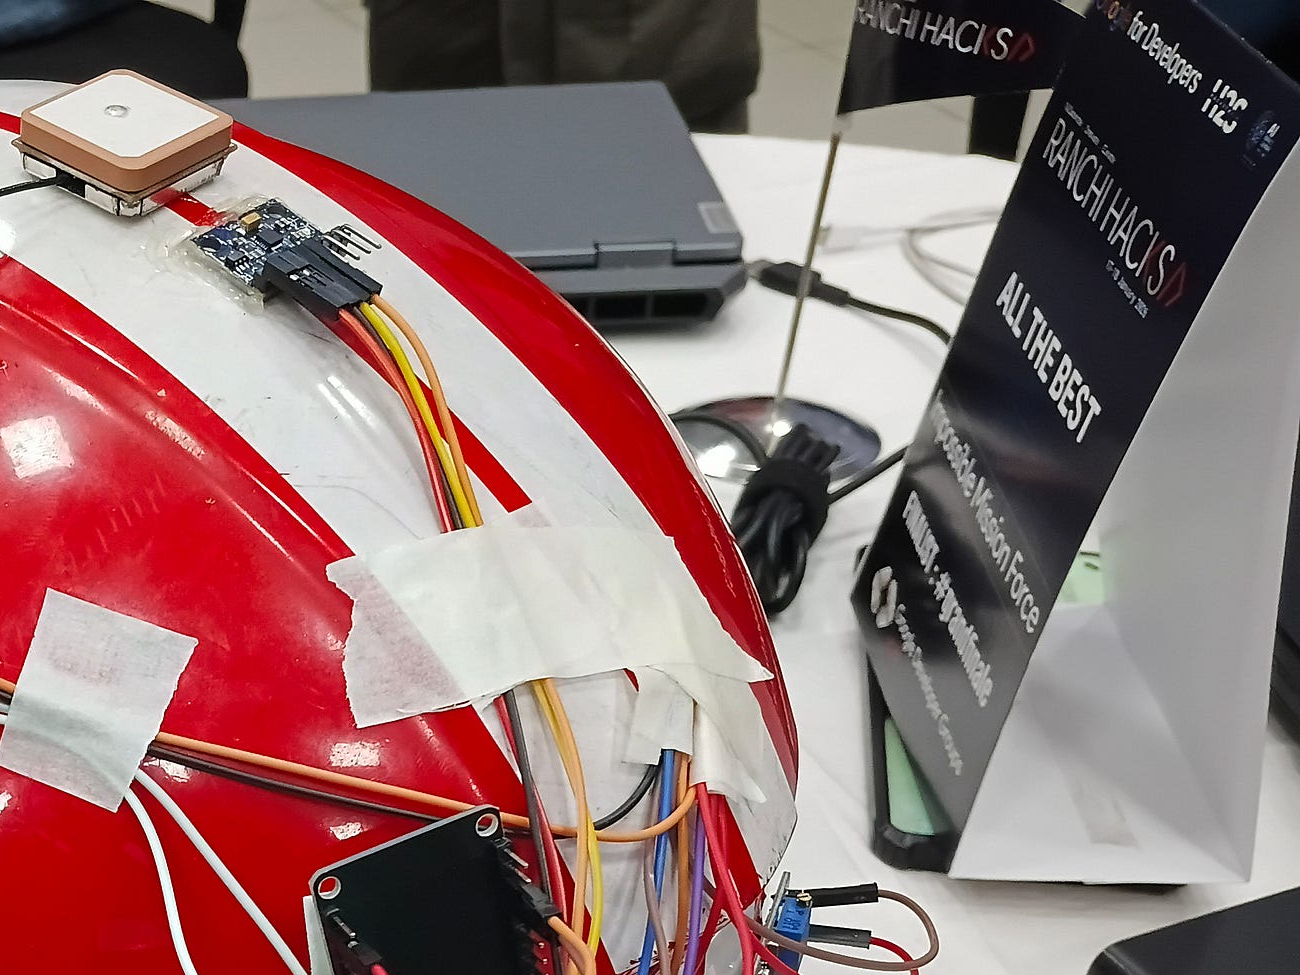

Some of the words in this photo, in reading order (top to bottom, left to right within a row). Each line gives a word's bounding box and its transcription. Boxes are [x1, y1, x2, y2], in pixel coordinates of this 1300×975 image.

[1126, 10, 1148, 43] for
[1141, 22, 1203, 94] Developers
[1042, 117, 1115, 222] RANCHI
[996, 271, 1031, 338] ALL
[1022, 306, 1062, 384] THE
[1048, 353, 1102, 443] BEST
[970, 476, 1011, 573] Mission
[1004, 550, 1040, 634] Force
